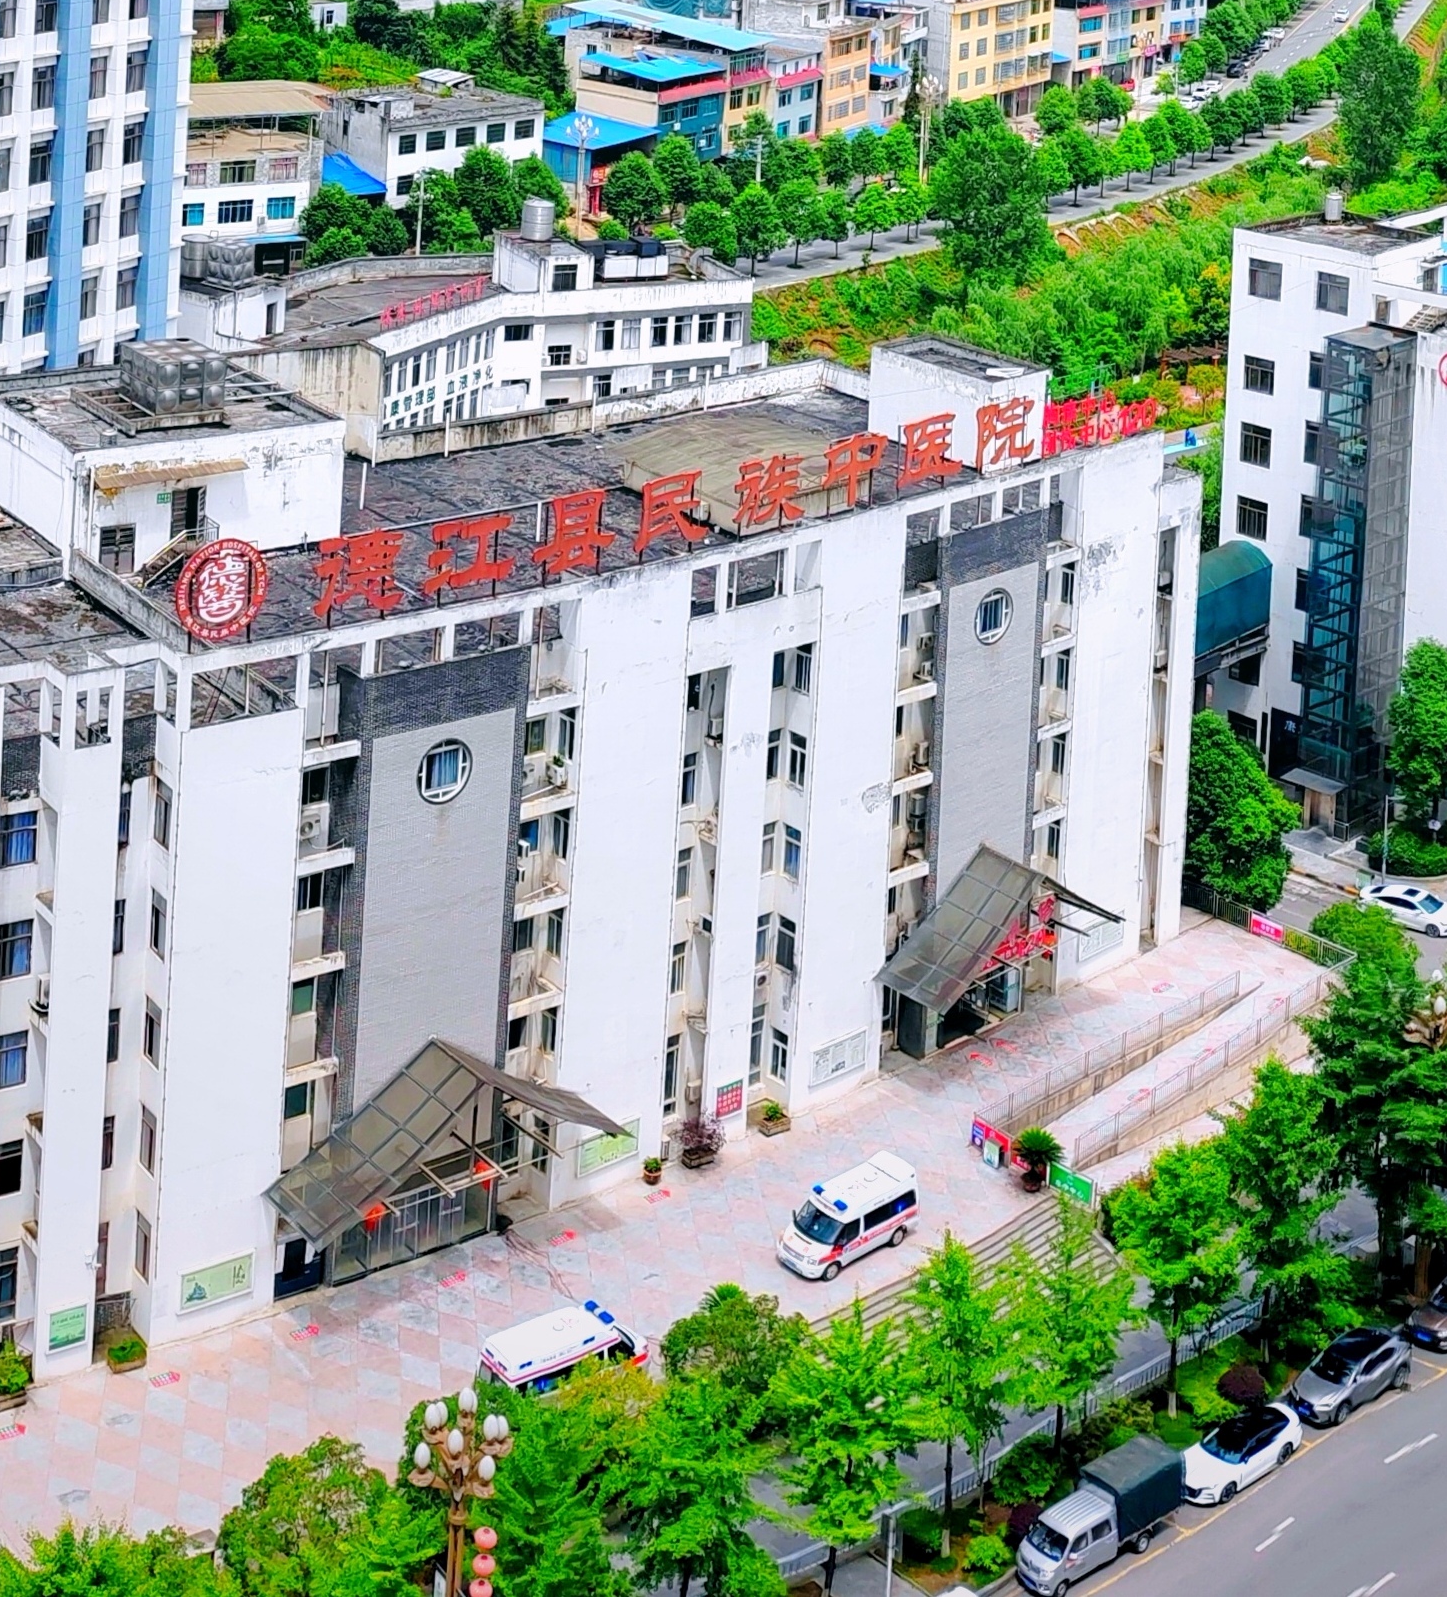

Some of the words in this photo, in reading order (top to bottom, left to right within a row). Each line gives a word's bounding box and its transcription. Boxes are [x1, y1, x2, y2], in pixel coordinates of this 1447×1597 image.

[177, 571, 192, 612] DEJIANG
[190, 543, 221, 570] NATION
[222, 541, 258, 562] HOSPITAL
[313, 397, 1035, 619] 德江县民族中医院
